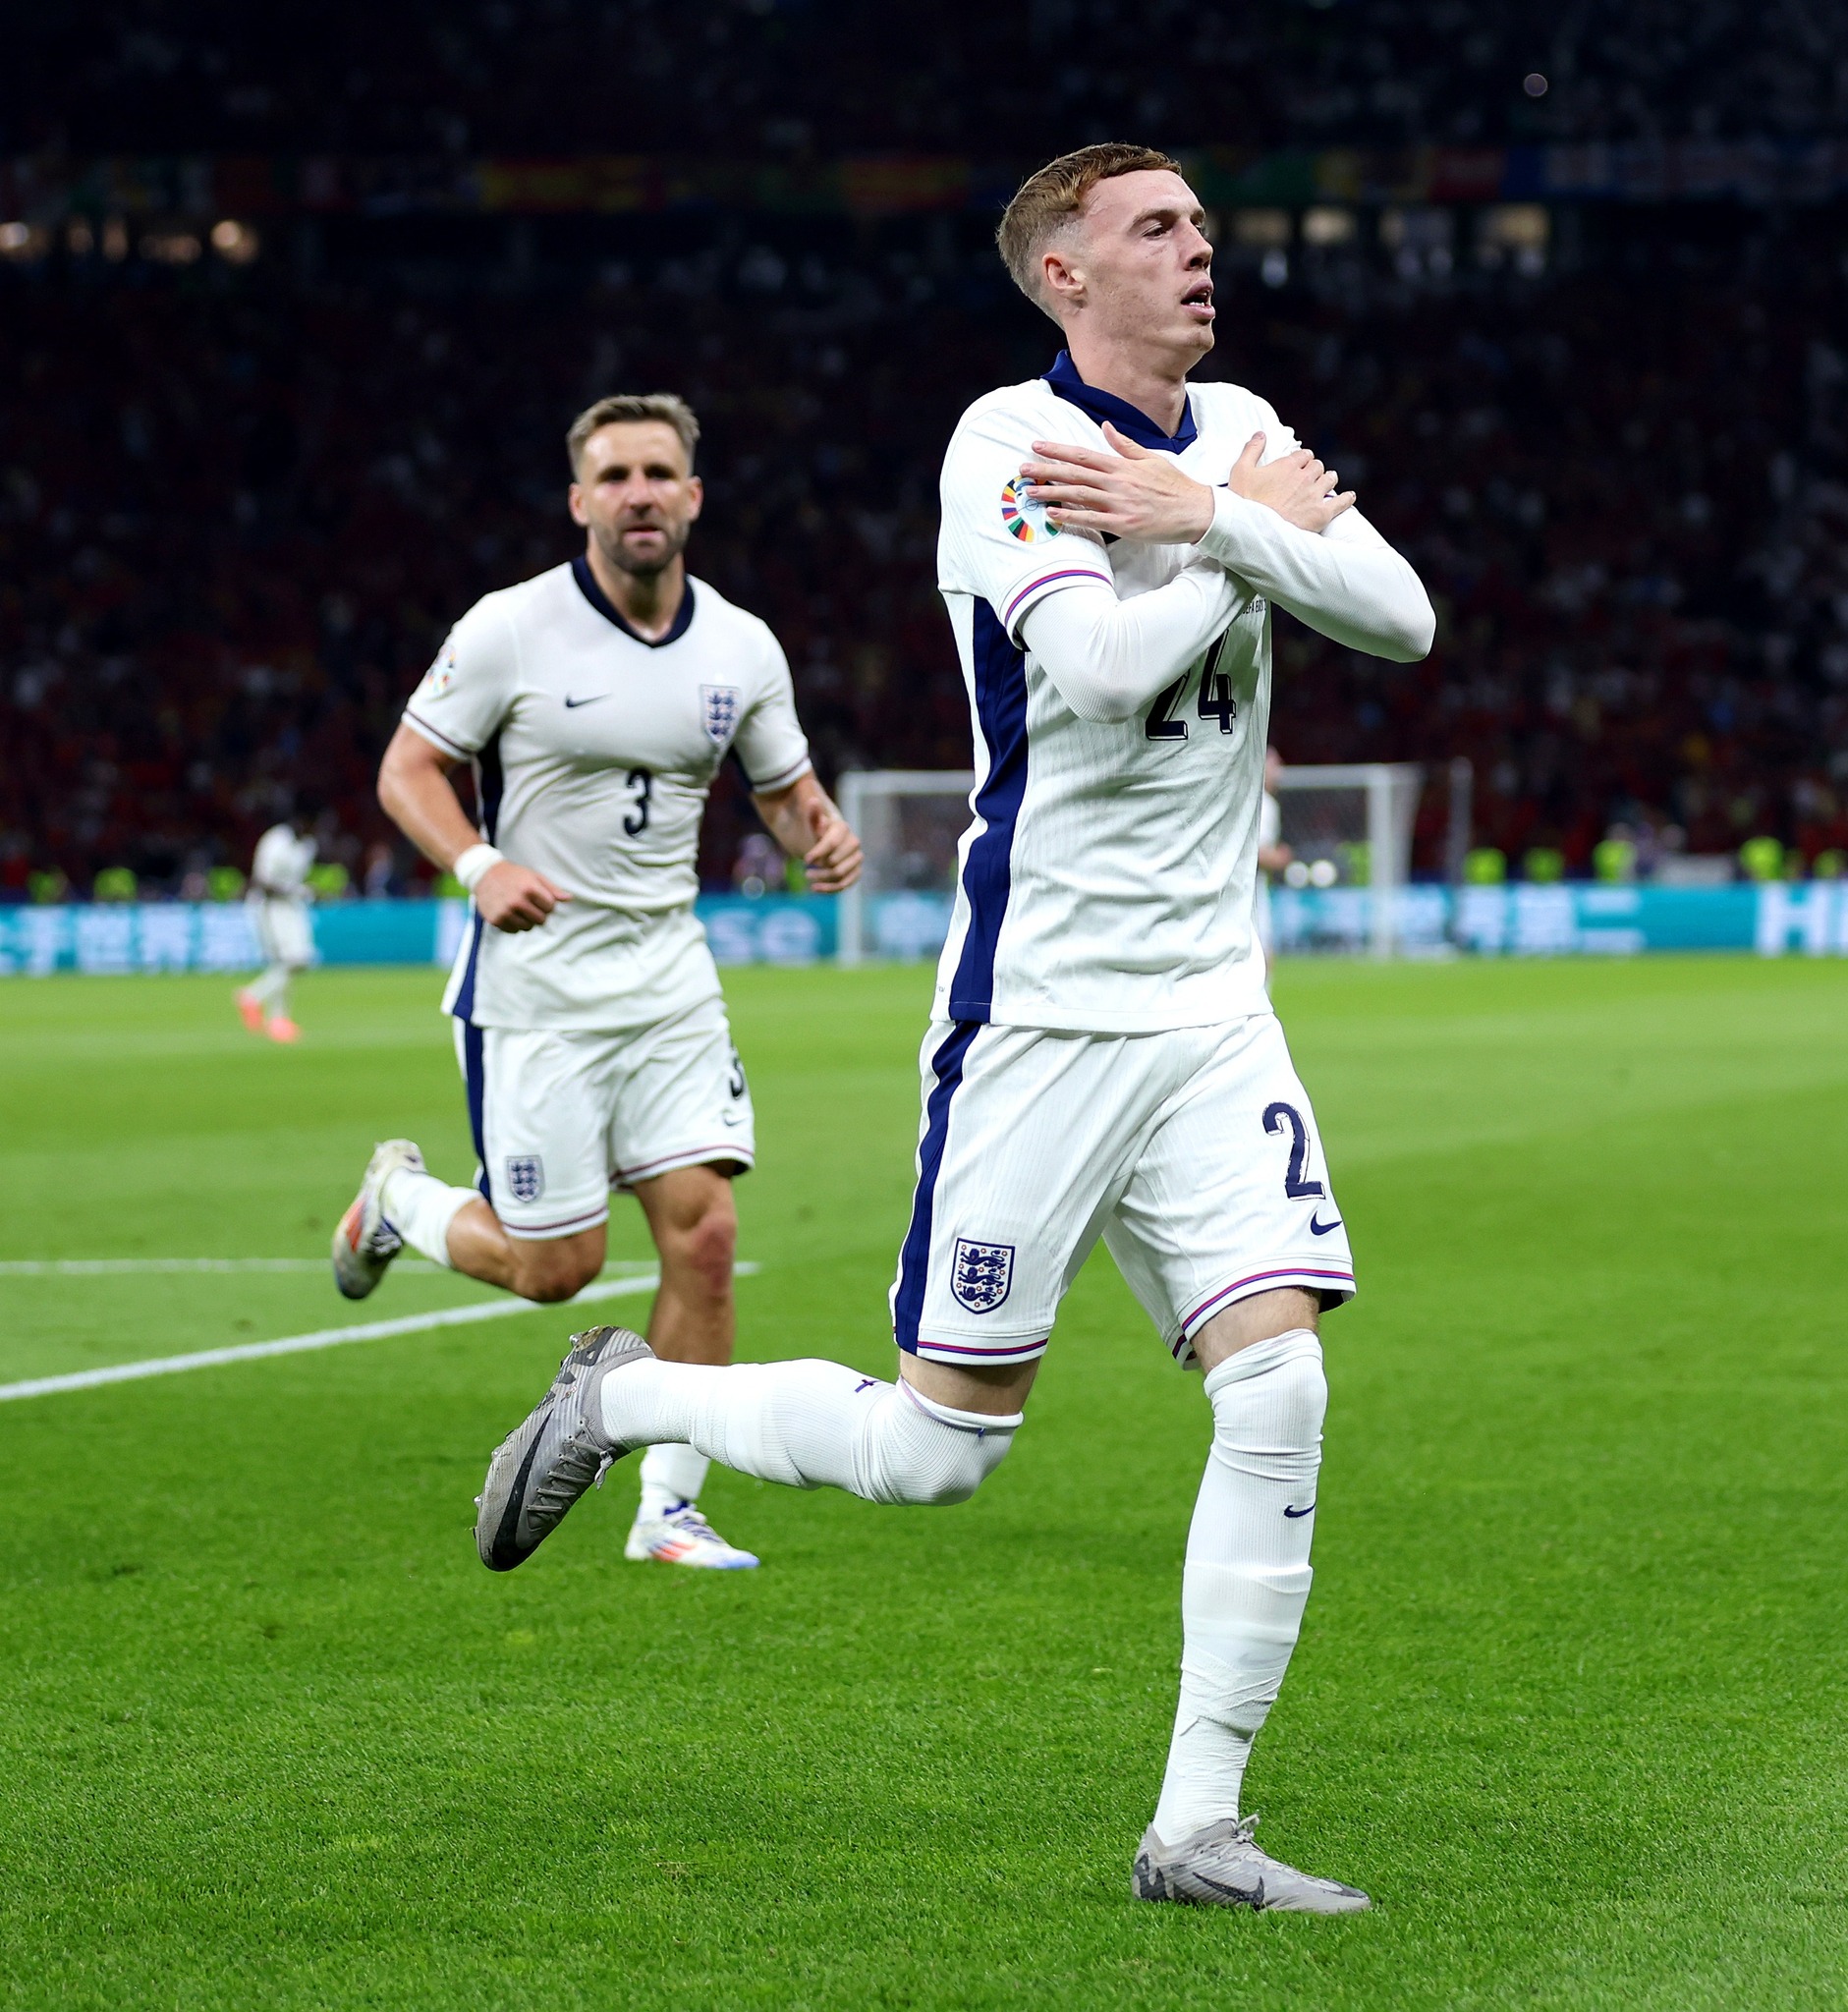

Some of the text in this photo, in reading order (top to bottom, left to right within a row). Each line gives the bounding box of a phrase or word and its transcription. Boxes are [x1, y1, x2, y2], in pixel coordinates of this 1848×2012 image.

[1146, 629, 1236, 741] 24
[623, 767, 652, 837] 3
[1262, 1101, 1326, 1202] 2
